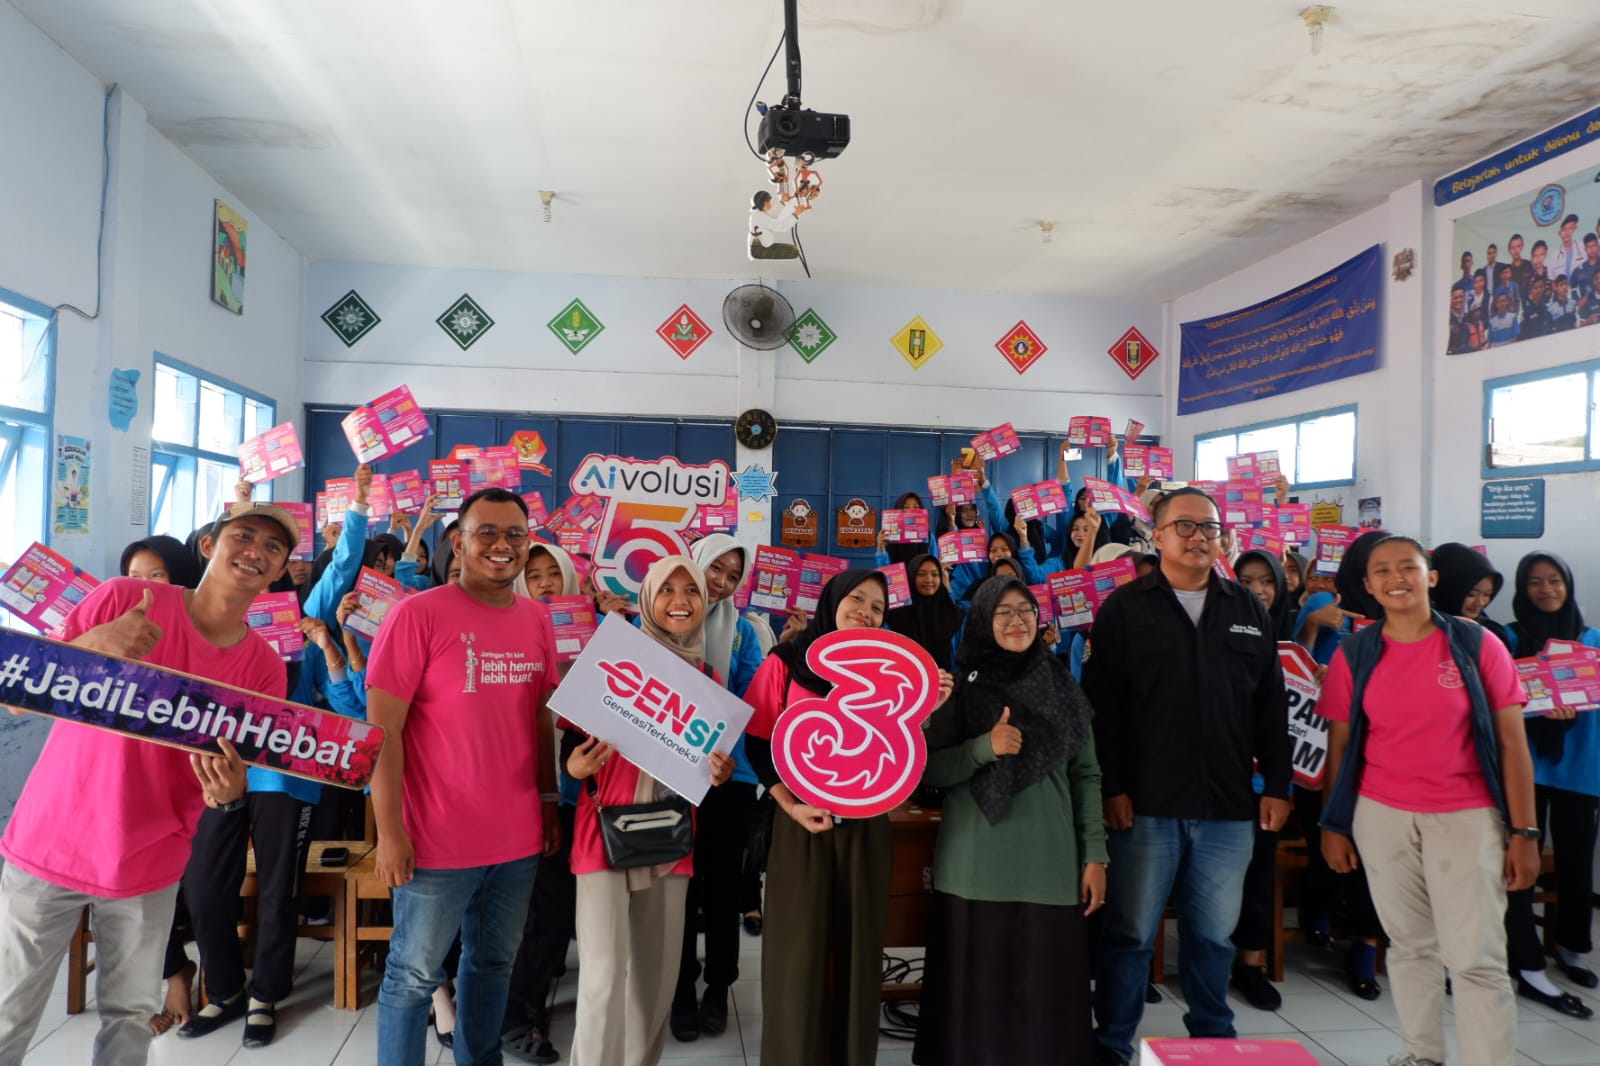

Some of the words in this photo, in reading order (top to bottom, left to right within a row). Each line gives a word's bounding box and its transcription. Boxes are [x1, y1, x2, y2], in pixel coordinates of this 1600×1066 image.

[1505, 149, 1540, 170] untuk
[961, 447, 975, 469] 7
[760, 550, 774, 558] Beda
[364, 572, 378, 582] Beda
[481, 660, 507, 672] lebih
[481, 672, 507, 684] lebih
[0, 654, 356, 769] #JadiLebihHebat
[602, 695, 701, 764] GenerasiTerkoneksi
[1288, 722, 1308, 738] dari
